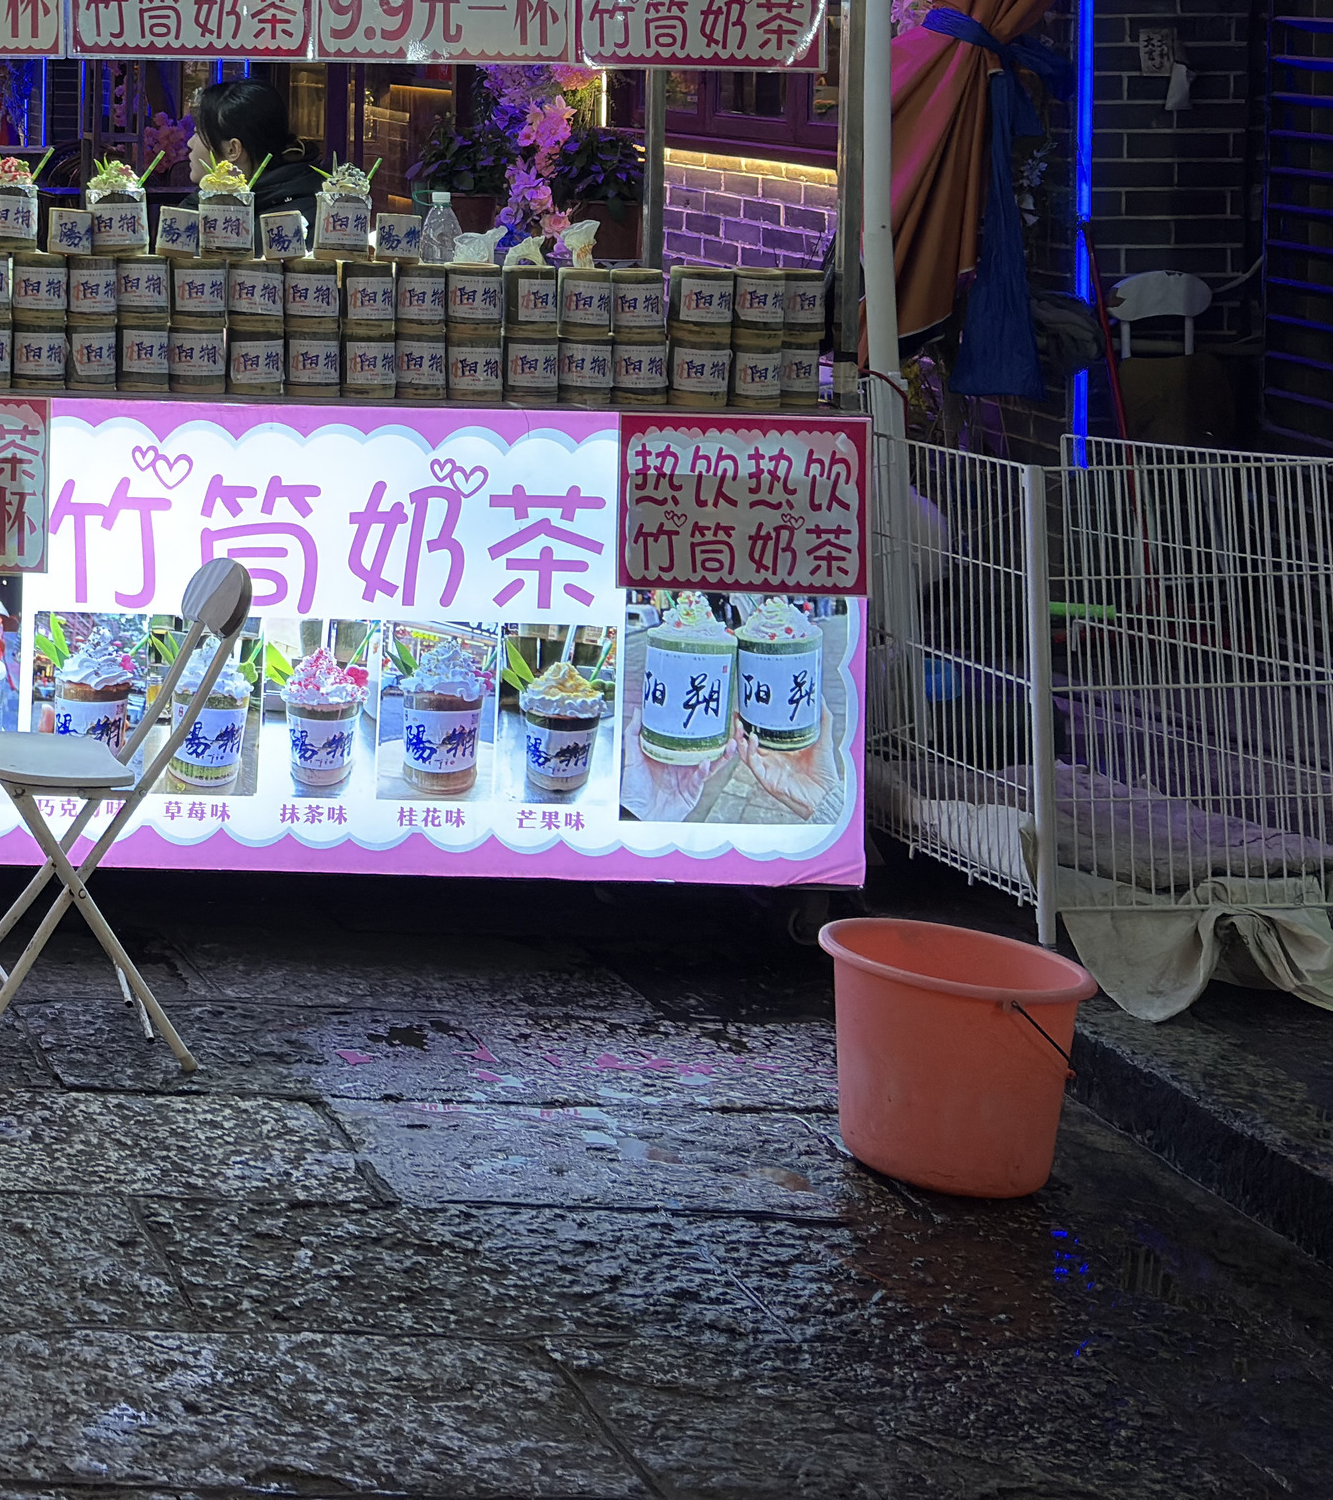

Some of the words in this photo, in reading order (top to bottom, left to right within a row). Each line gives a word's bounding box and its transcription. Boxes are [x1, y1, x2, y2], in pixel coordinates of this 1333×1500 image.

[22, 277, 63, 300] 阳朔
[122, 273, 162, 296] 阳朔
[237, 281, 278, 305] 阳朔
[290, 283, 332, 307] 阳朔
[457, 284, 499, 308] 阳朔
[619, 294, 661, 316] 阳朔
[23, 343, 64, 365] 阳朔
[176, 344, 218, 366] 阳朔
[241, 350, 280, 372] 阳朔
[459, 357, 500, 380] 阳朔
[567, 353, 607, 377] 阳朔
[623, 355, 664, 378] 阳朔
[686, 359, 727, 381] 阳朔
[633, 442, 852, 513] 热饮热饮
[47, 473, 607, 615] 竹筒奶茶
[633, 521, 853, 579] 竹筒奶茶
[643, 670, 722, 730] 阳朔
[163, 801, 232, 821] 草莓味
[279, 804, 348, 825] 抹茶味
[397, 806, 467, 828] 桂花味
[517, 810, 585, 831] 芒果味
